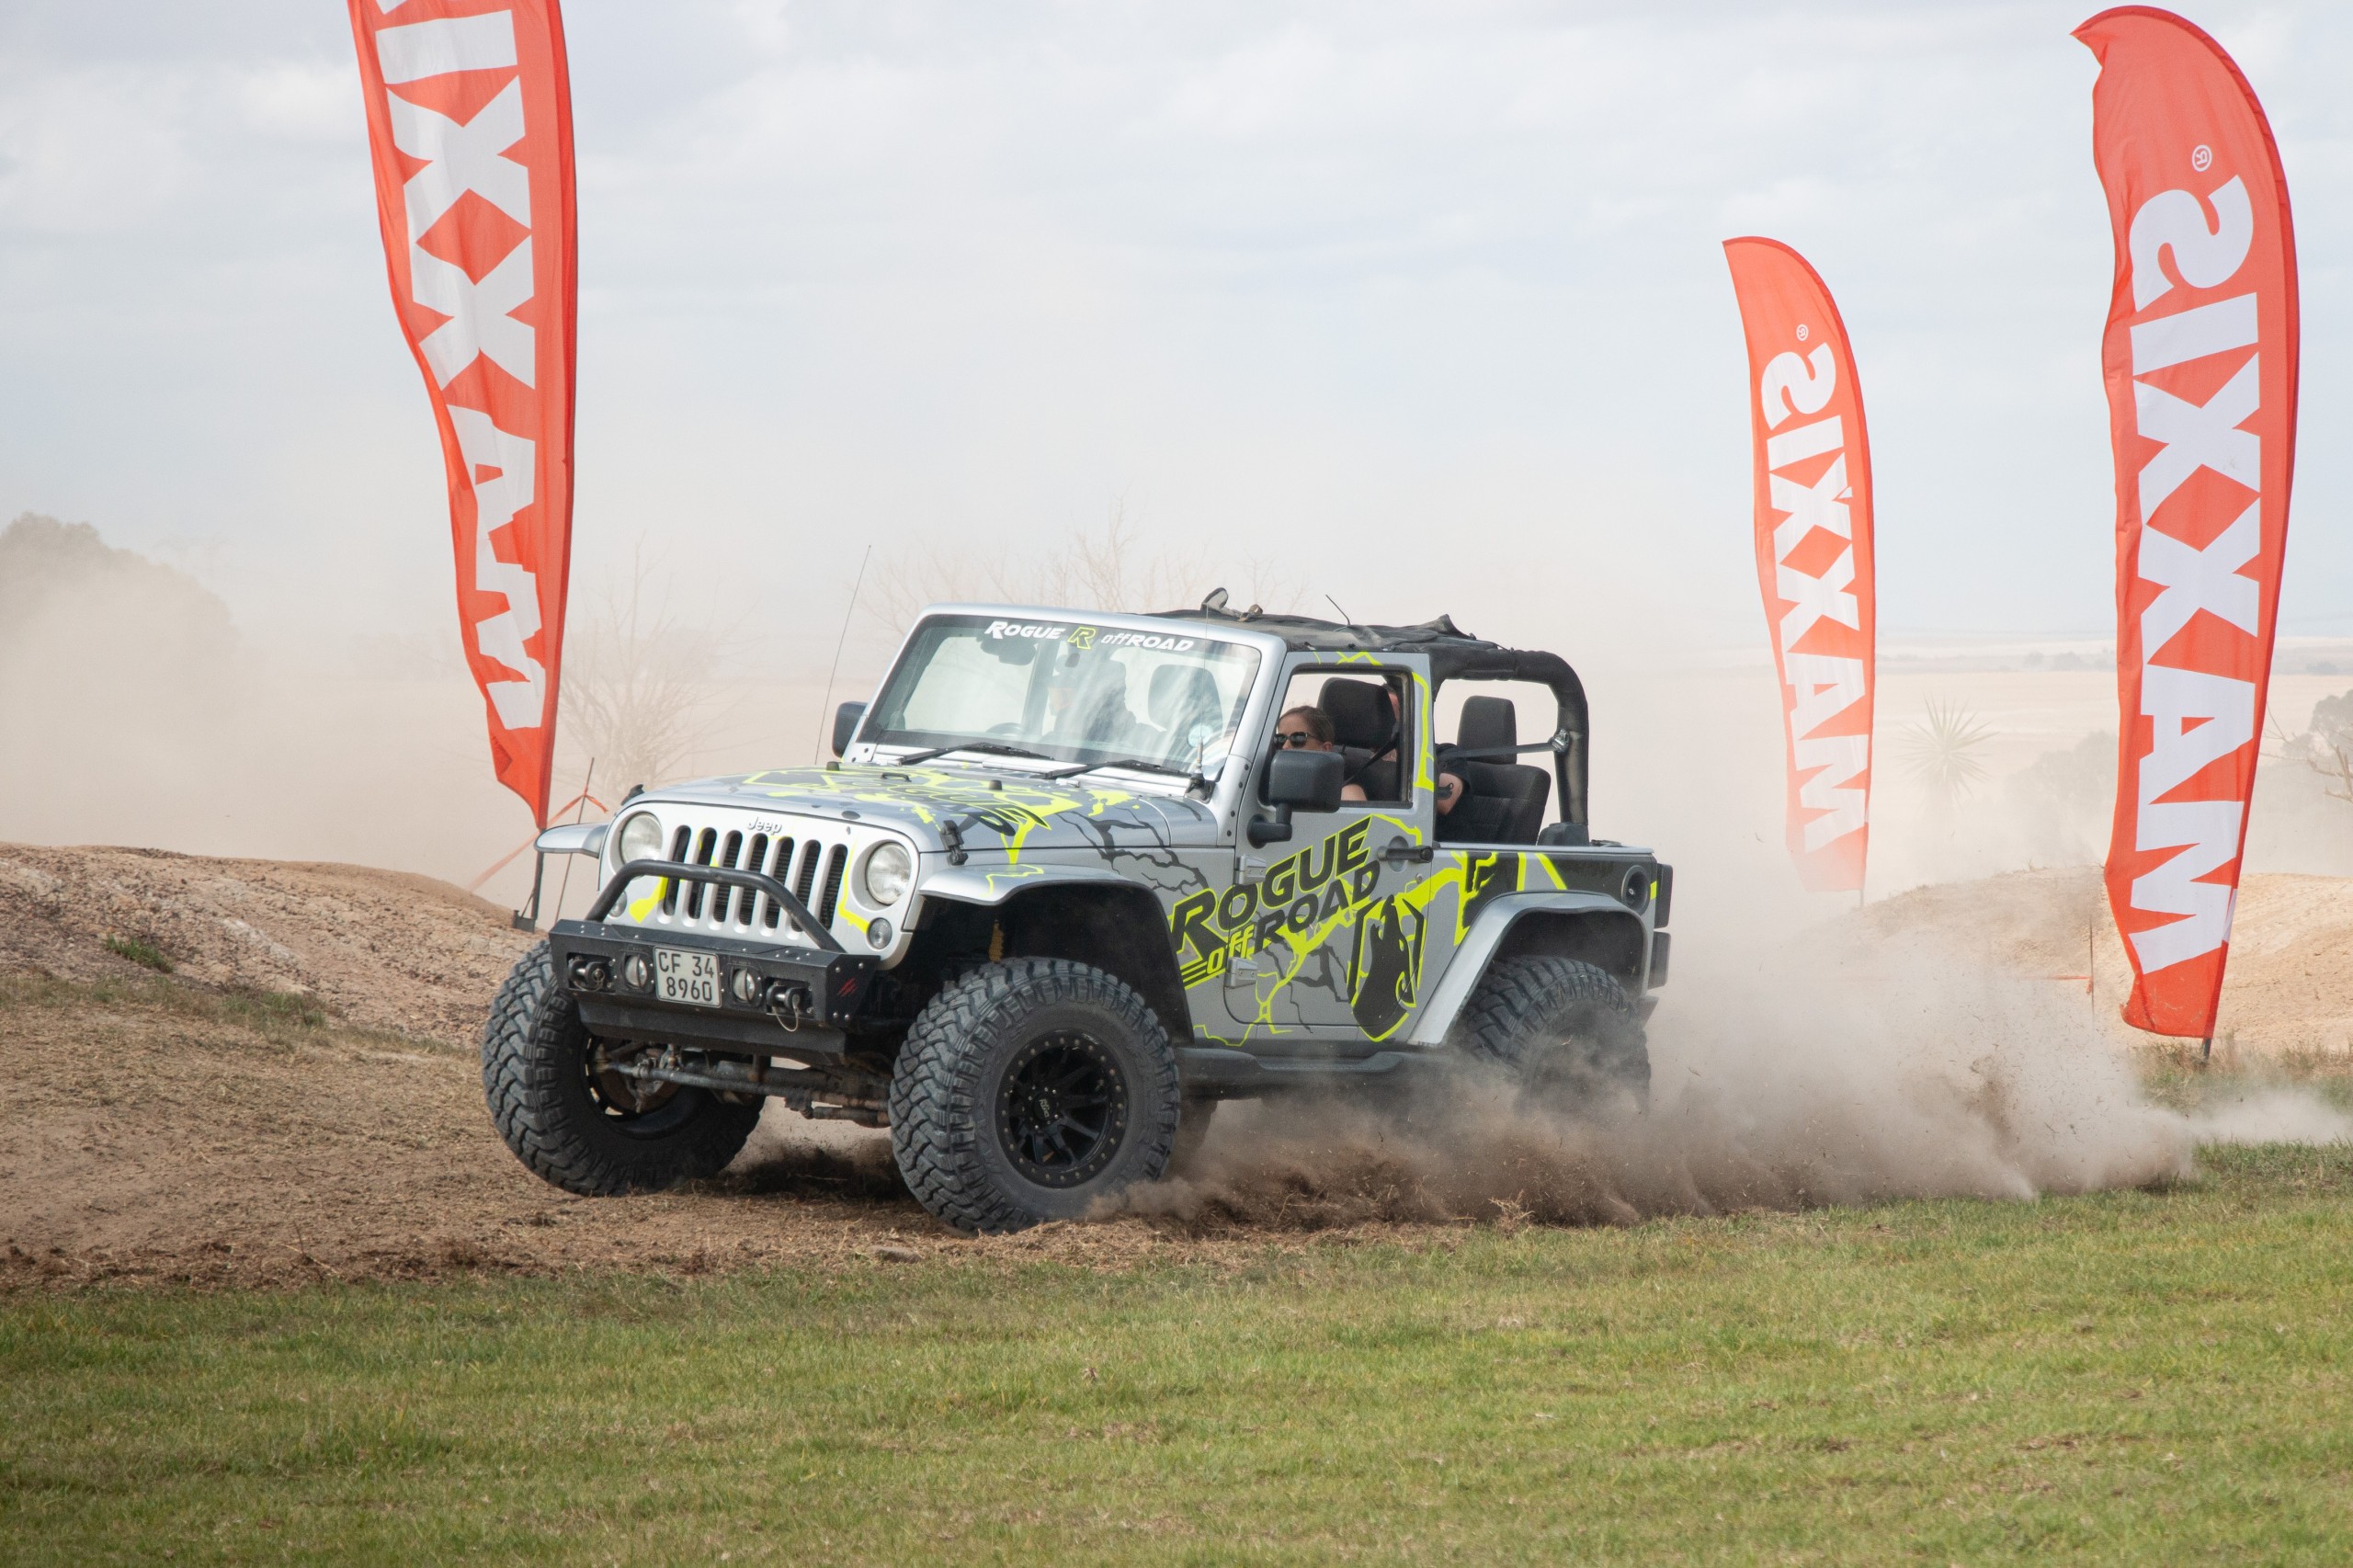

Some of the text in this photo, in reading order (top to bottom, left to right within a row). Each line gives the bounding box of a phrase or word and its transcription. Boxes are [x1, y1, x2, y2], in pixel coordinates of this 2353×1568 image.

[984, 620, 1065, 640] ROGUE
[747, 816, 782, 835] Jeep
[1170, 815, 1371, 962] ROGUE
[658, 951, 714, 978] CF 34
[666, 976, 712, 1002] 8960
